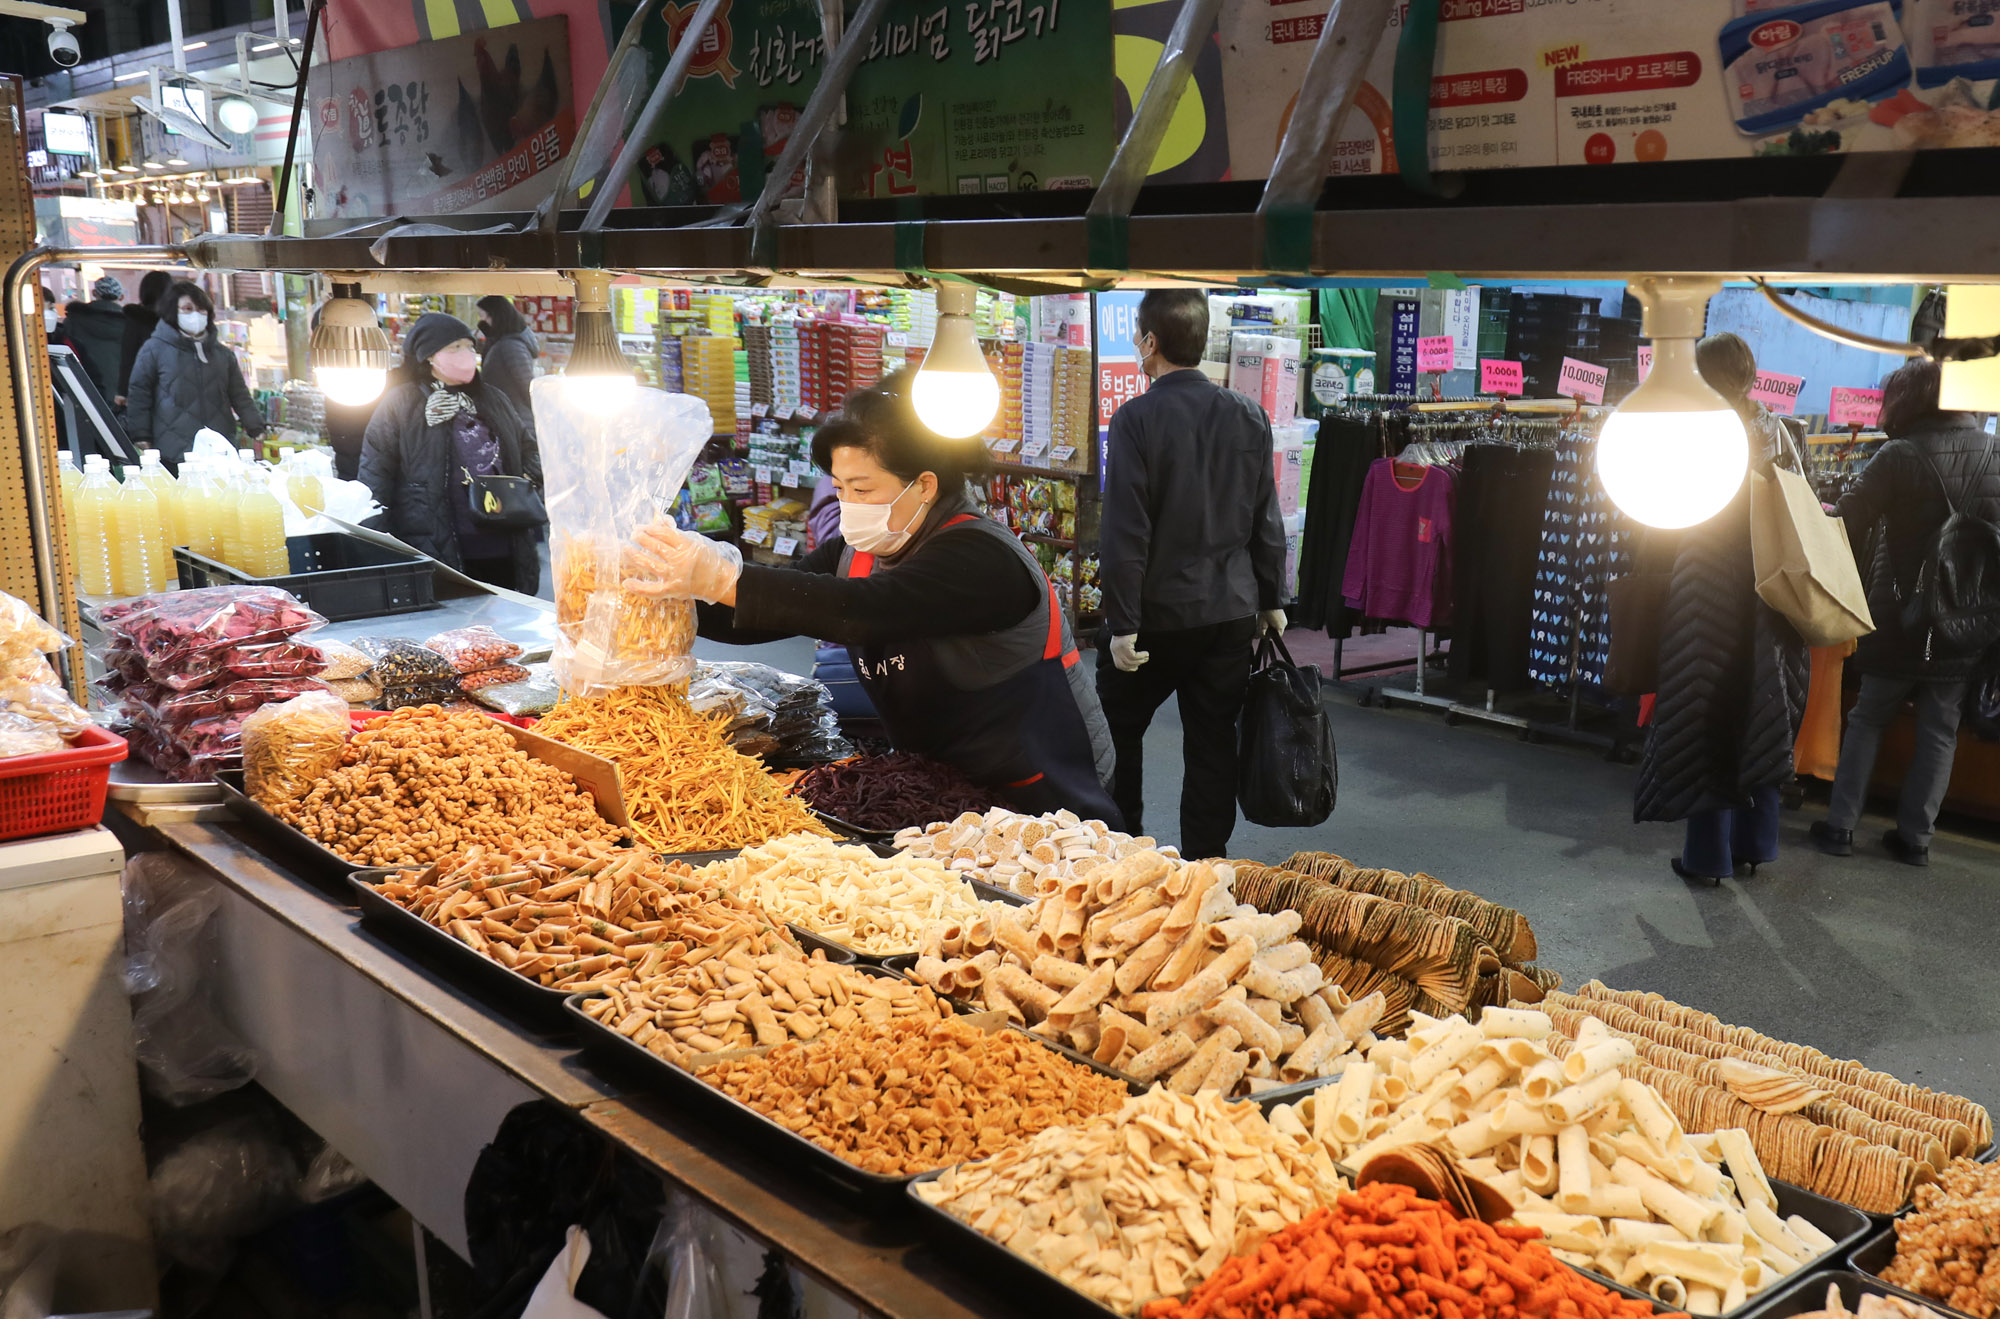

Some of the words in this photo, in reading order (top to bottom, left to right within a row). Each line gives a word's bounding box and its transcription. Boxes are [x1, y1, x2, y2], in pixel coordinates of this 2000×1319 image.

[1442, 1, 1482, 18] Chilling
[965, 0, 1057, 63] 닭고기
[1275, 21, 1295, 41] 국내
[1297, 18, 1318, 38] 최초
[1758, 24, 1792, 42] 하림
[1544, 45, 1580, 67] NEW
[1566, 66, 1633, 86] FRESH-UP
[1636, 60, 1690, 80] 프로젝트
[1450, 79, 1483, 97] 제품의
[1484, 75, 1508, 94] 특징
[475, 163, 507, 200] 담백한
[507, 150, 531, 183] 맛이
[531, 123, 560, 171] 일품
[1562, 365, 1605, 388] 10,000원
